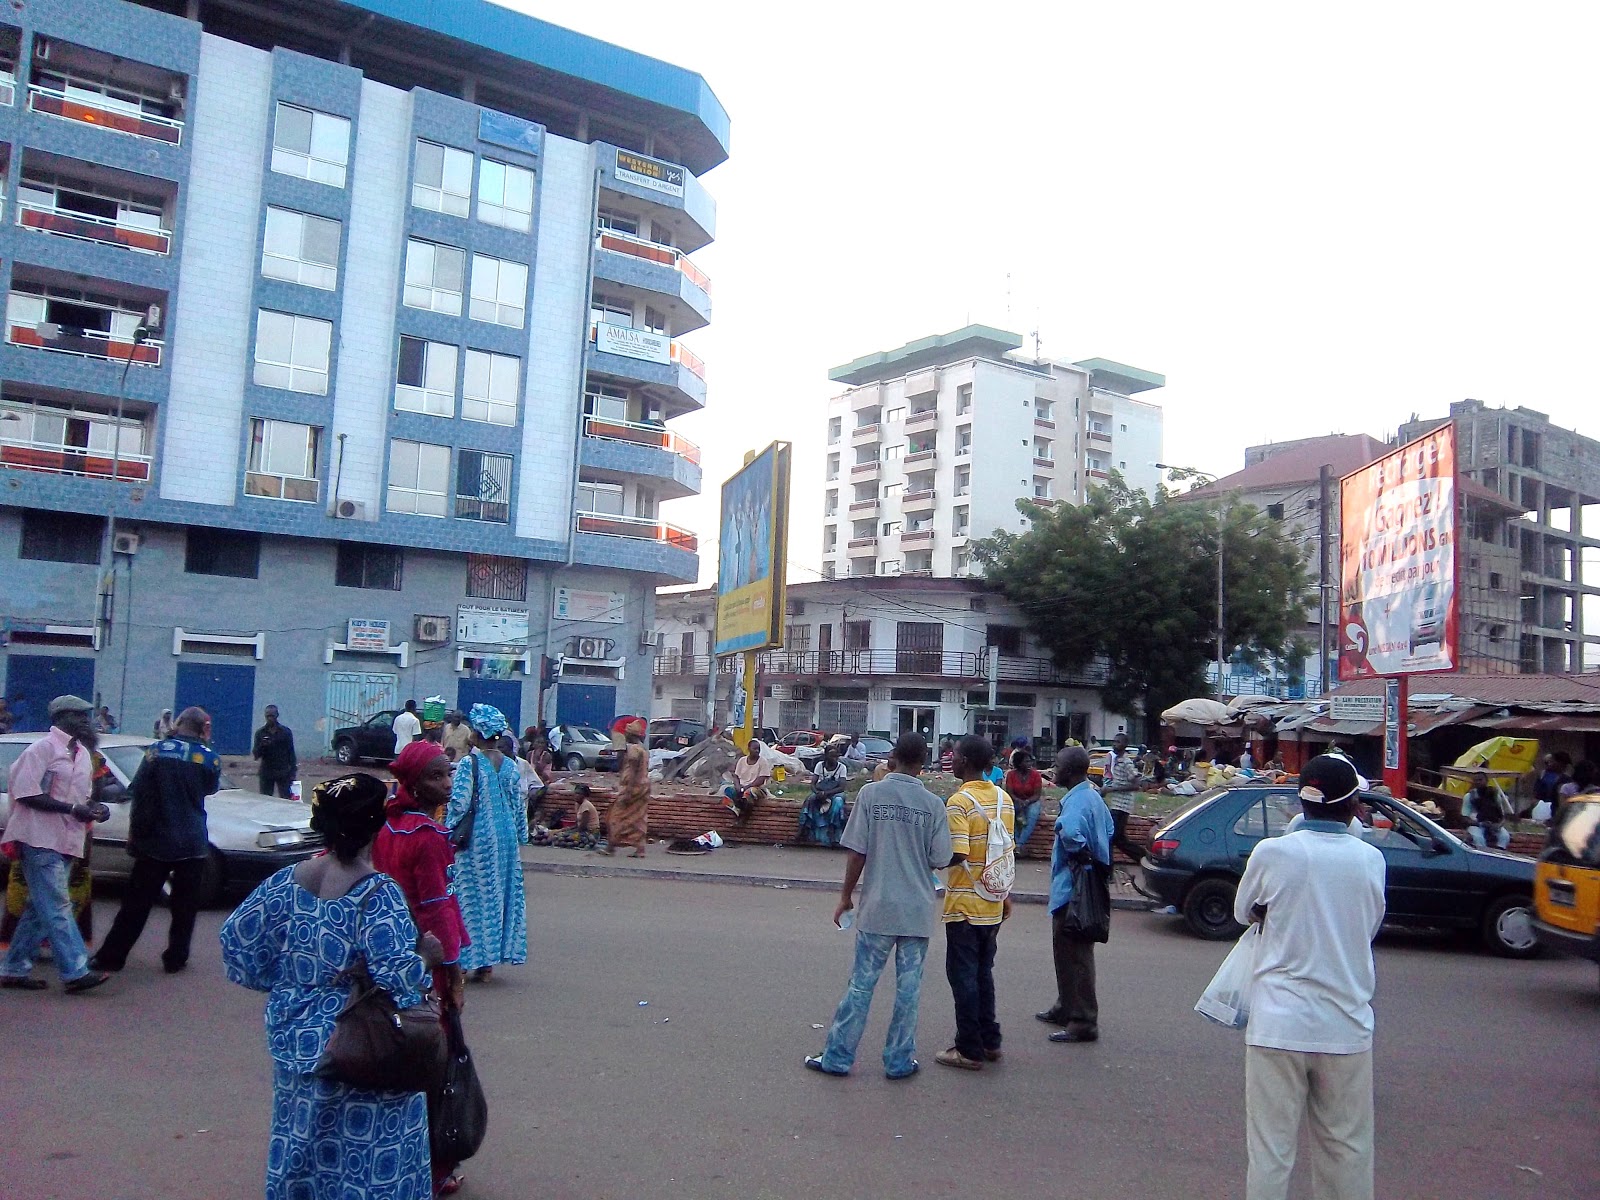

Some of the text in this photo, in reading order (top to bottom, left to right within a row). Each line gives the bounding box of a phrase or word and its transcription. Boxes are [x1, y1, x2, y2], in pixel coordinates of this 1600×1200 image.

[618, 154, 660, 172] WESTERN
[630, 164, 660, 177] UNION
[619, 171, 650, 185] TRANSFERT
[666, 169, 681, 182] yes
[1375, 492, 1432, 536] Gagnez
[1377, 527, 1436, 566] MILLIONS
[872, 804, 932, 828] SECURITY
